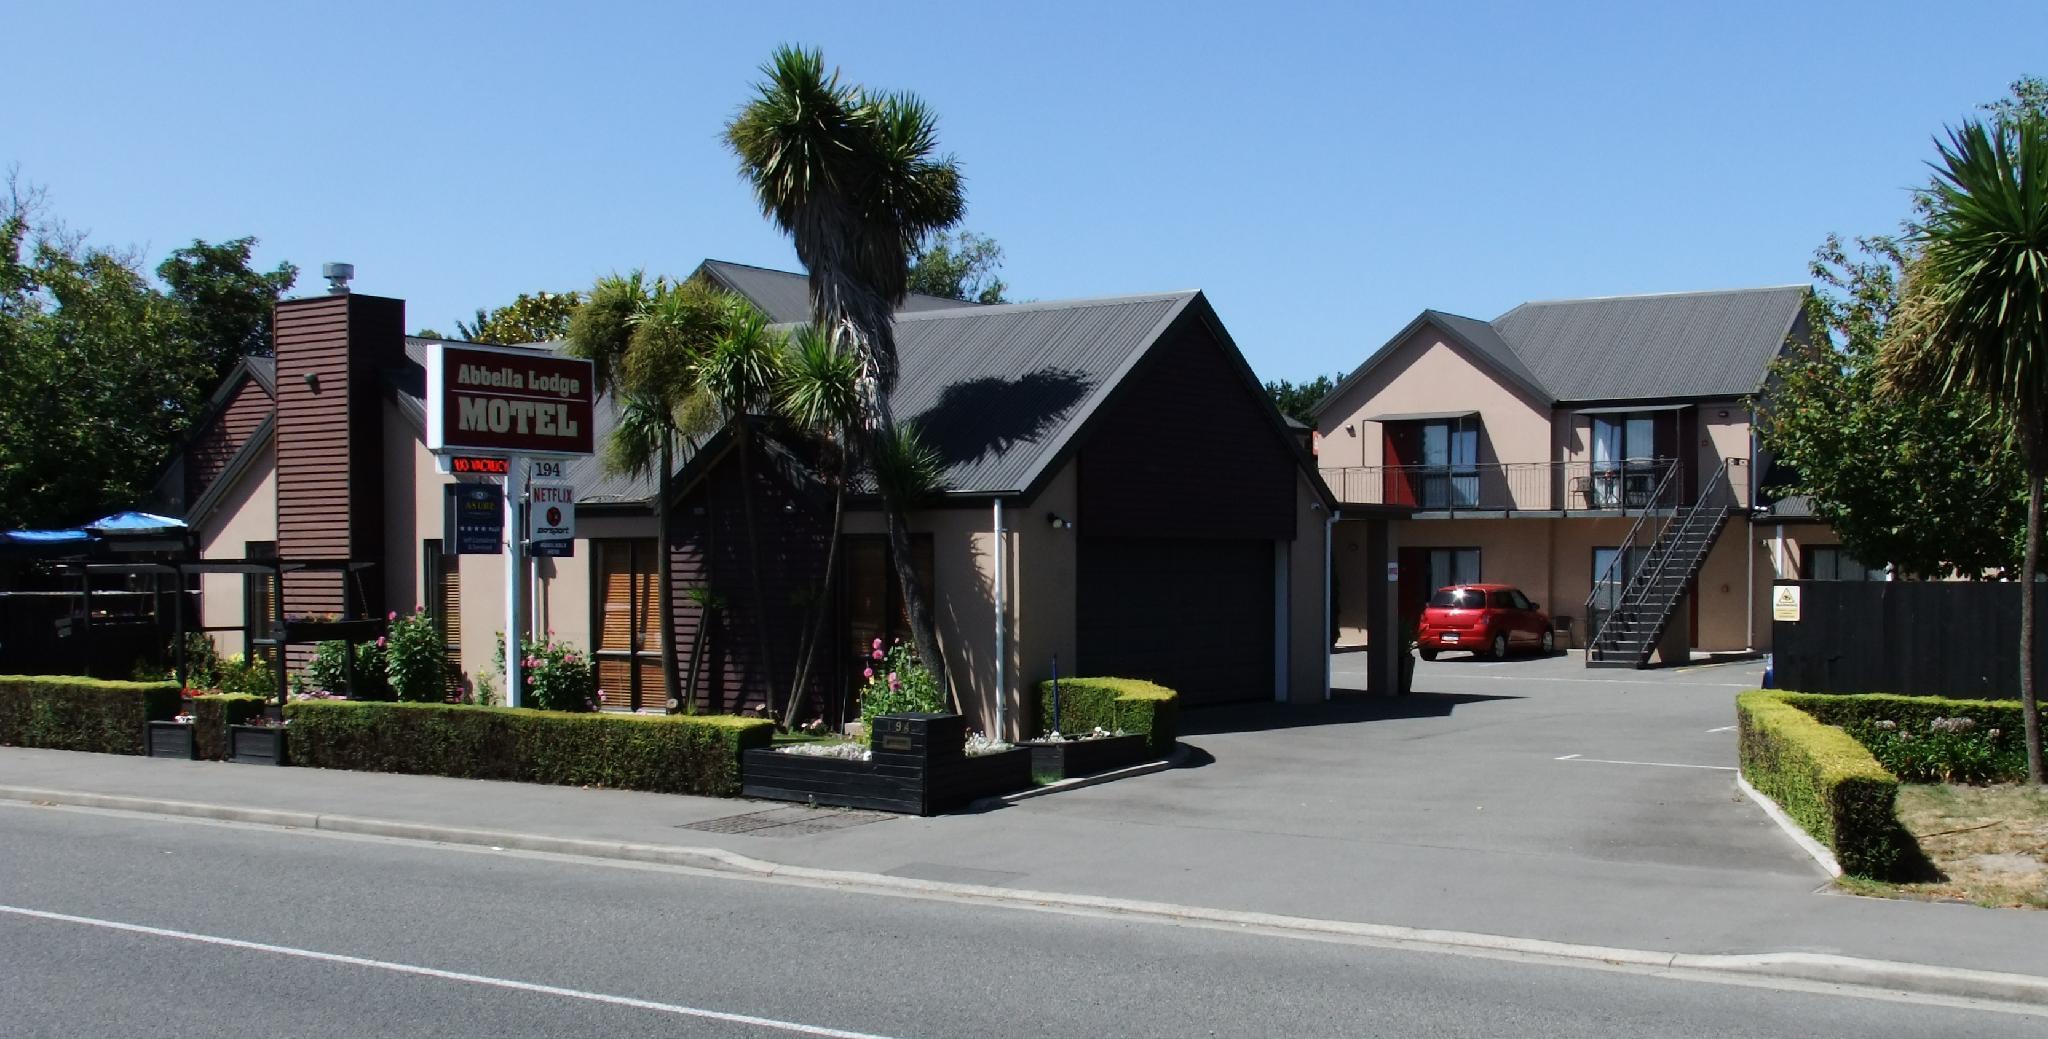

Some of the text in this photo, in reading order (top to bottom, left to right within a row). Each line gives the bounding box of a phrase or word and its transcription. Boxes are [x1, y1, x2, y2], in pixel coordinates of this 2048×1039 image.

[458, 363, 580, 398] Abbella Lodge
[458, 396, 578, 438] MOTEL
[535, 462, 561, 477] 194
[533, 487, 573, 504] NETFLIX
